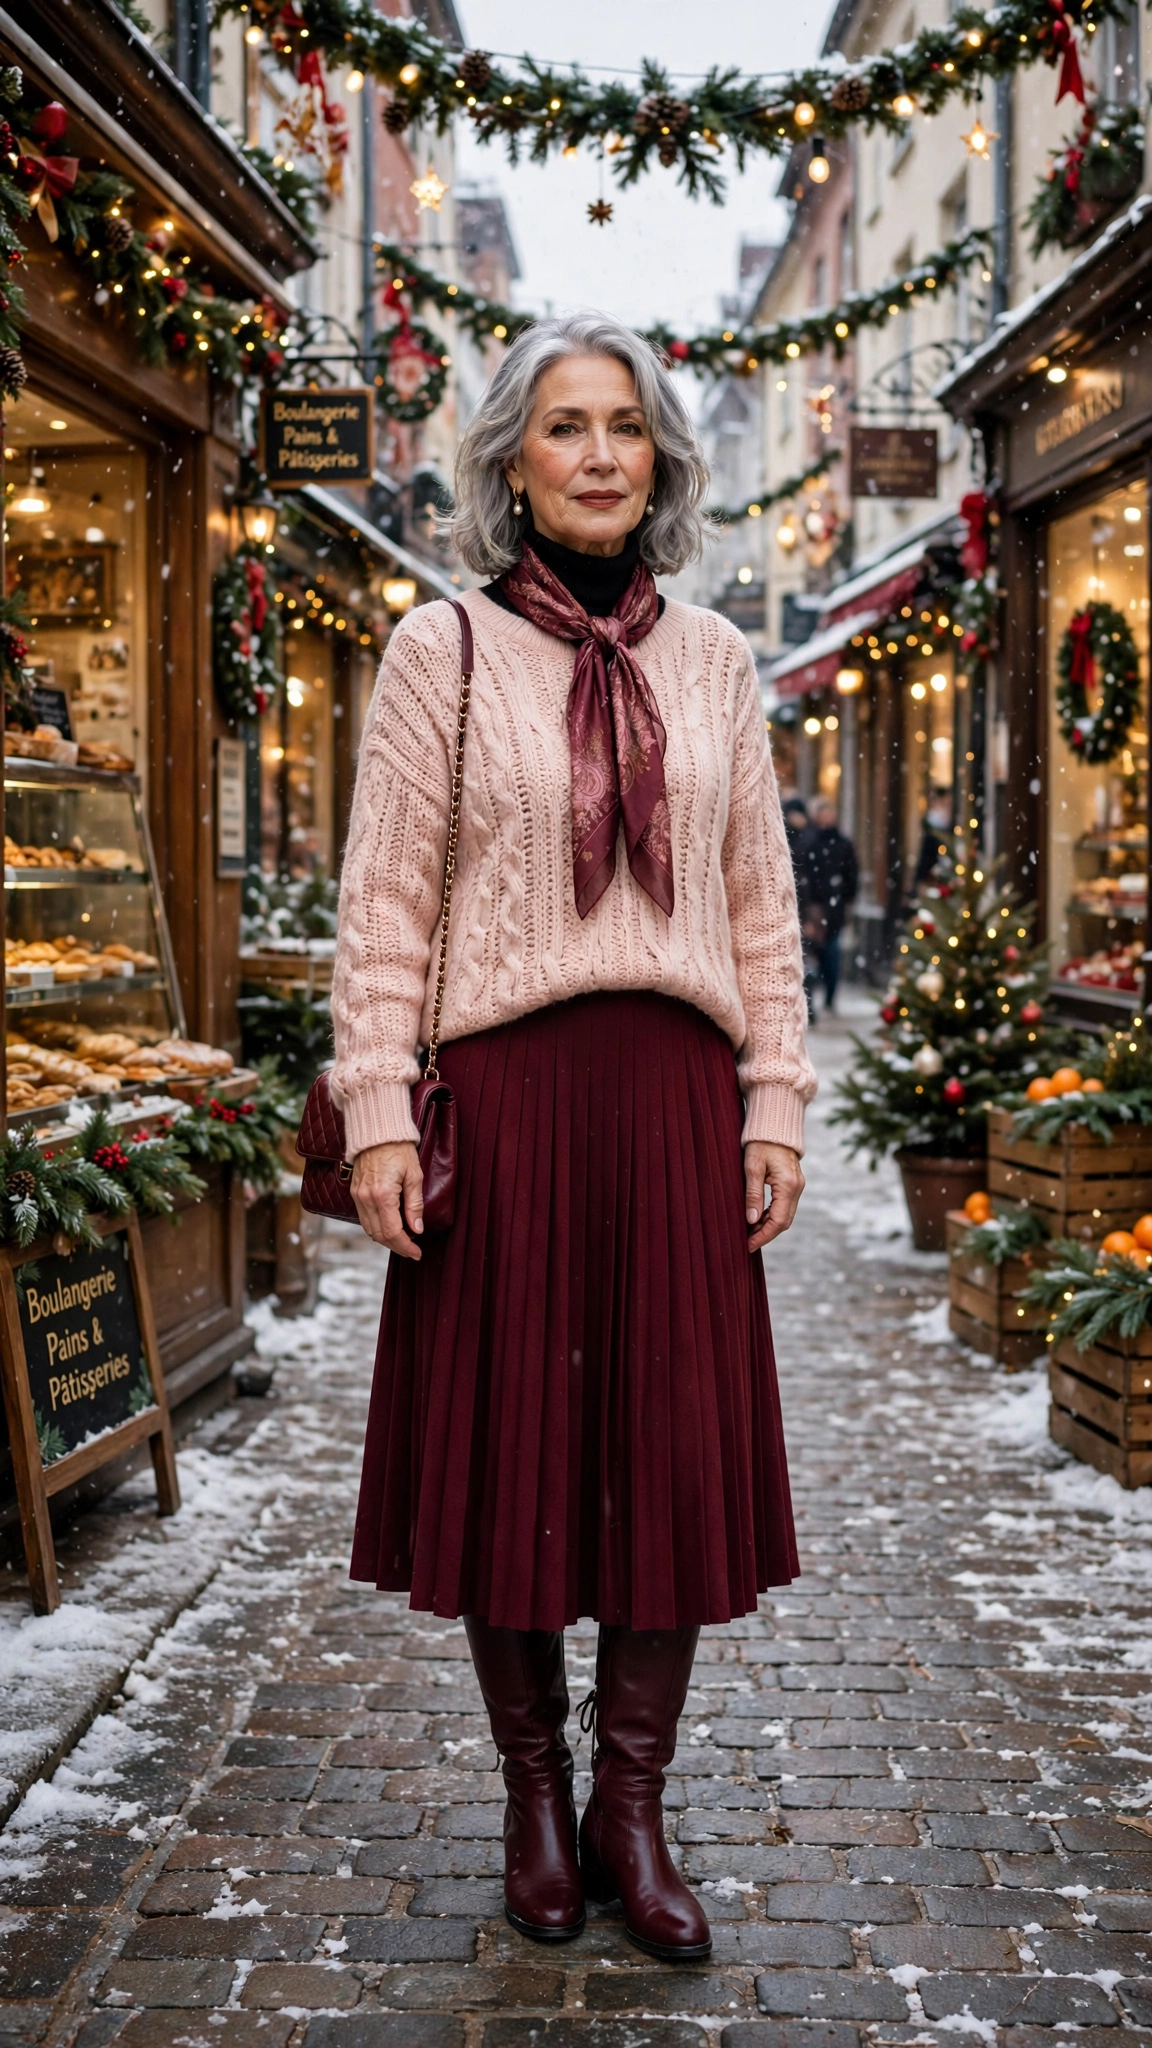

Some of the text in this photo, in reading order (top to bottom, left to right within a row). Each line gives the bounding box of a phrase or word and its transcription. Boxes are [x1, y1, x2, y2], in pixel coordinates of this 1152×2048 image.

[273, 400, 360, 426] Boulangerie
[283, 426, 339, 446] Pains &
[26, 1266, 117, 1324] Boulangerie
[46, 1316, 104, 1366] Pains &
